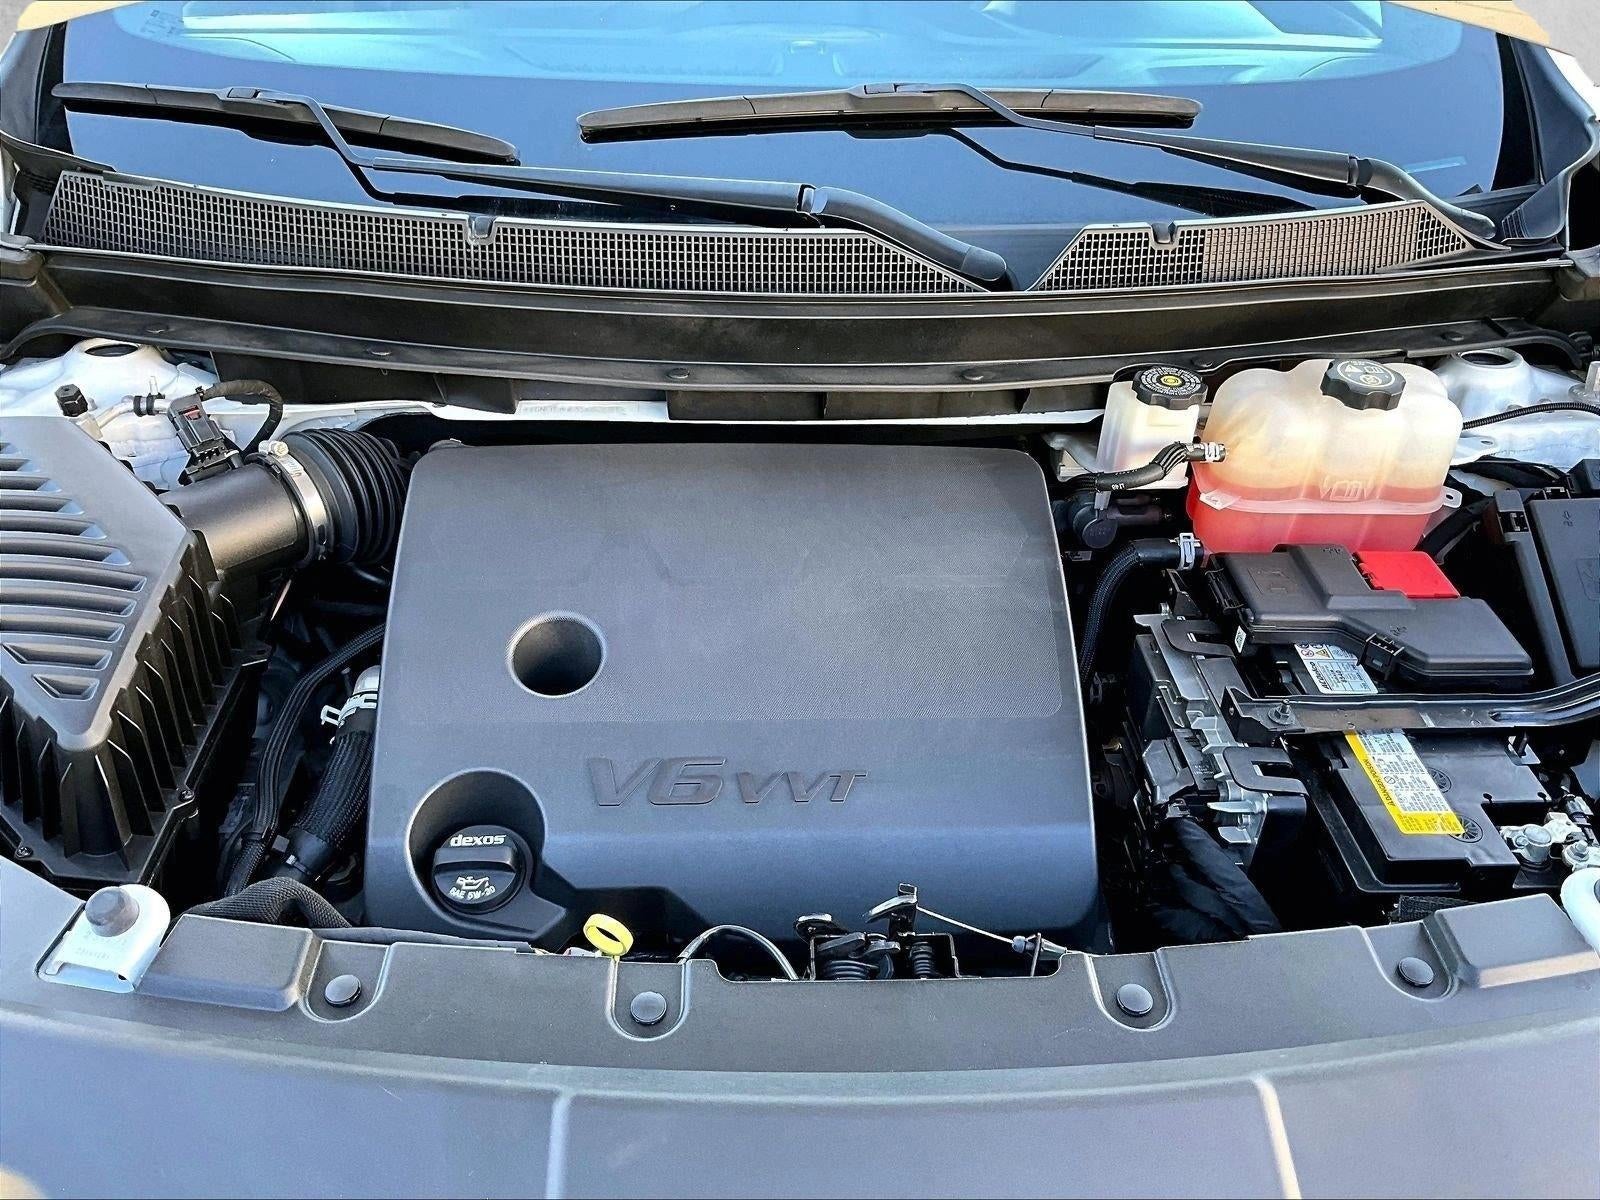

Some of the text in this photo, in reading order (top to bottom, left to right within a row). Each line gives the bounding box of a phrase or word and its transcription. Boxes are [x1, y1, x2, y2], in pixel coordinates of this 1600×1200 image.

[587, 756, 868, 806] V6 VVT
[1363, 759, 1391, 801] DANGER POISON
[450, 834, 507, 847] dexos
[449, 887, 466, 899] SAE
